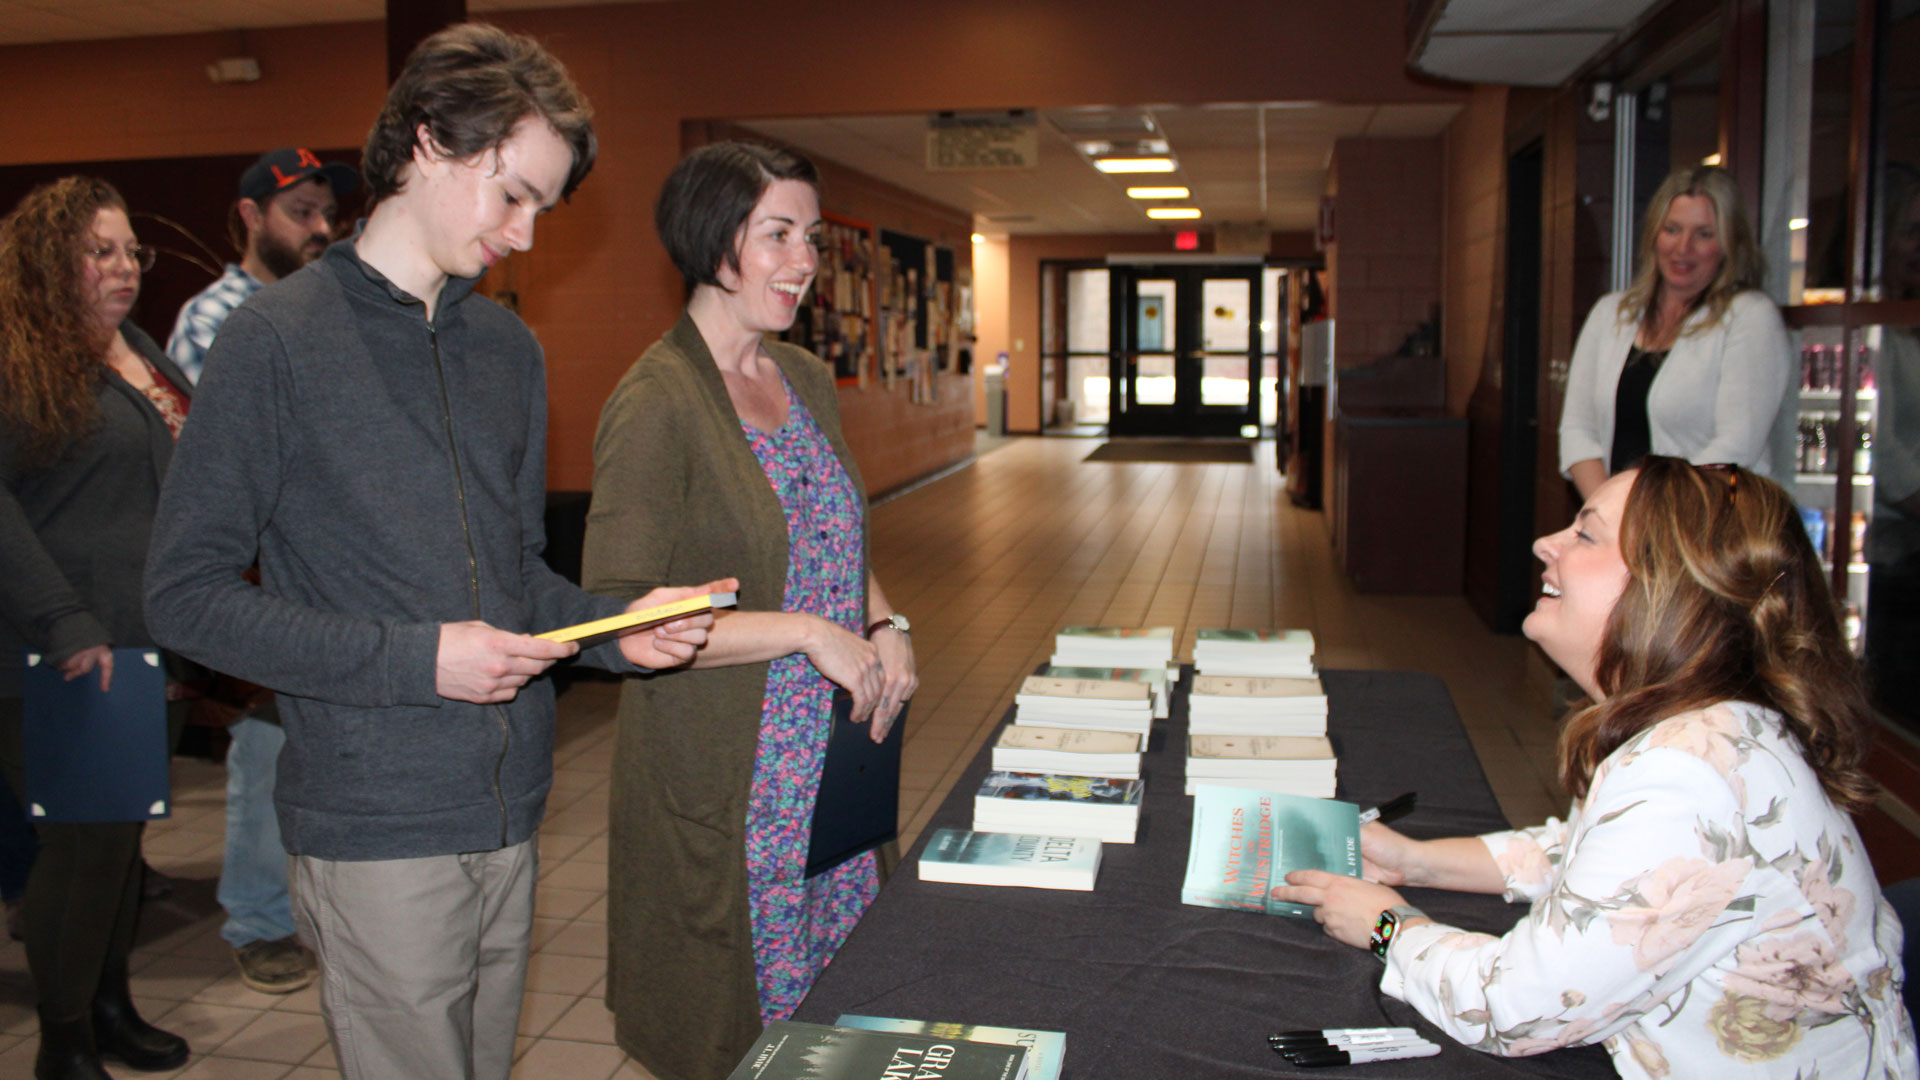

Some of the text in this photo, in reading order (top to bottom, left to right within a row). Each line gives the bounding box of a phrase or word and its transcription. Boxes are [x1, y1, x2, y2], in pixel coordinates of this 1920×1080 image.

[1040, 837, 1075, 862] DELTA
[1224, 808, 1244, 883] WITCHES
[1249, 797, 1272, 897] WESTRIDGE
